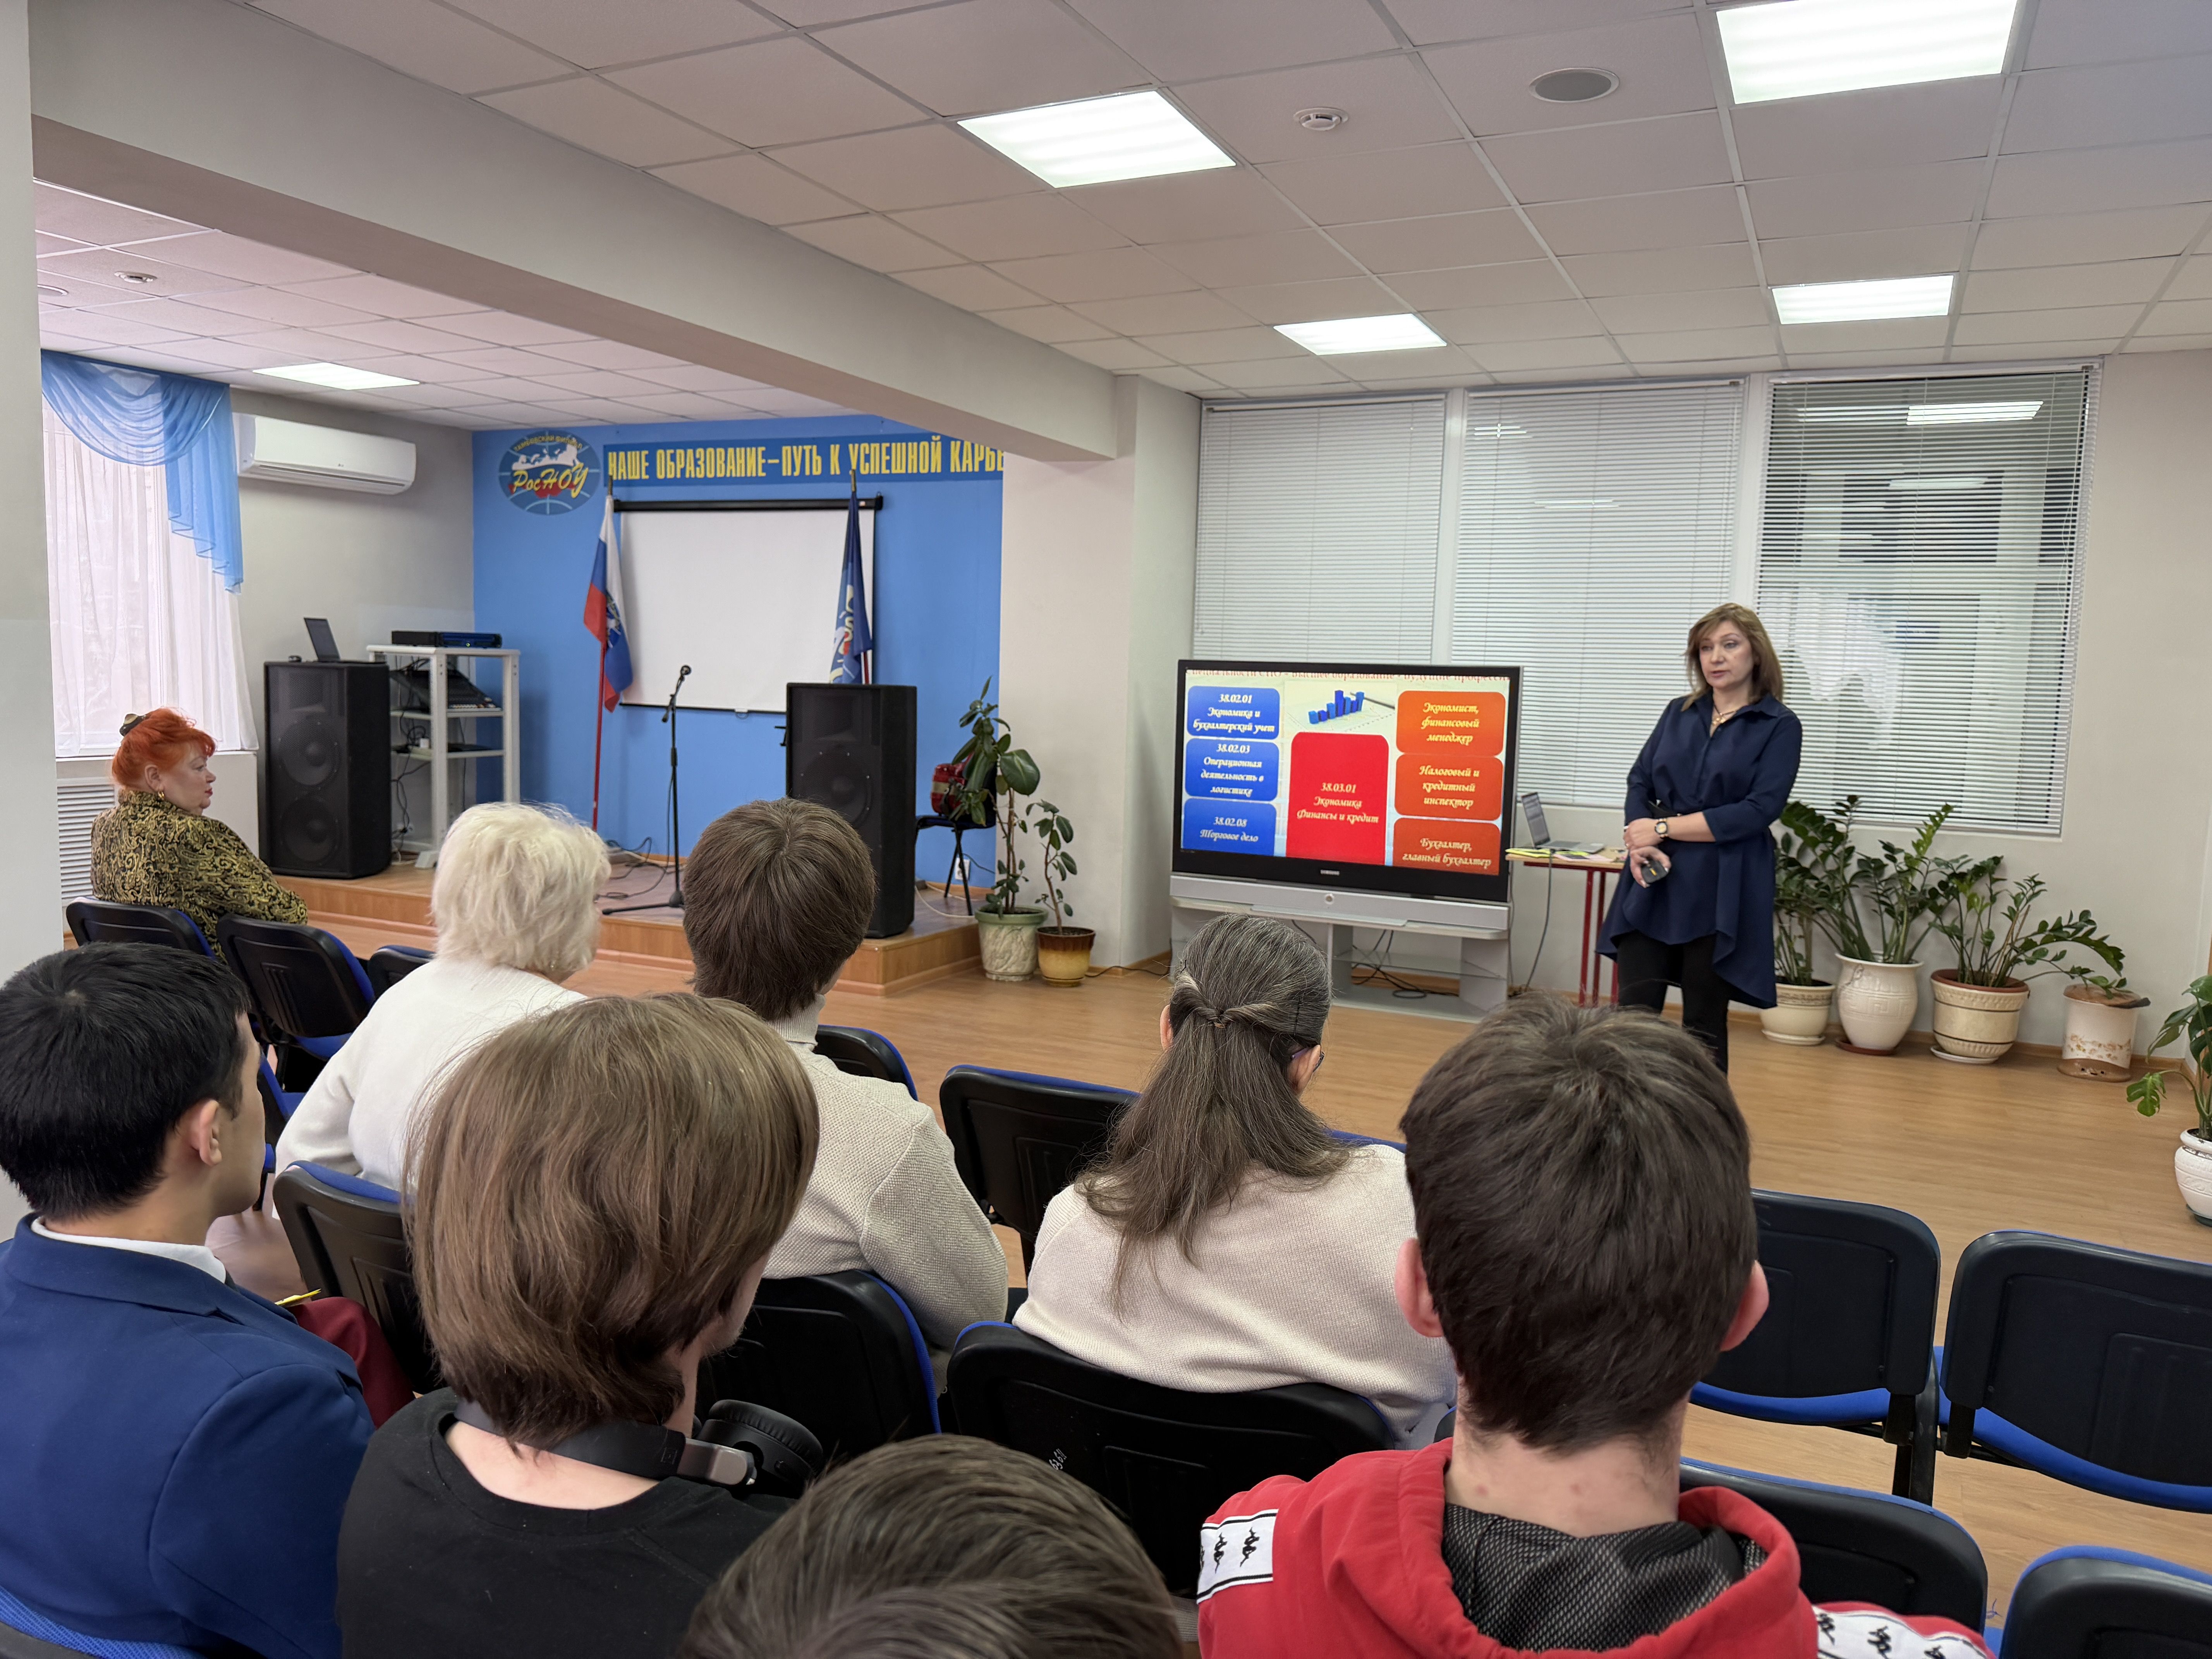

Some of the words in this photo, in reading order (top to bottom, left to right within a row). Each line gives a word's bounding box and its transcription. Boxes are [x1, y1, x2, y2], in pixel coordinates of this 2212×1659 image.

[608, 451, 649, 480] НАШЕ
[830, 444, 840, 475] К
[848, 435, 941, 475] УСПЕШНОЙ
[514, 462, 589, 499] РосНОУ
[1218, 694, 1252, 704] 38.02.01
[1207, 707, 1253, 720] Экономика
[1422, 702, 1479, 714] Экономист,
[1193, 718, 1253, 733] бухгалтерский
[1253, 725, 1275, 734] учет
[1420, 716, 1480, 730] финансовый
[1426, 731, 1474, 746] менеджер
[1216, 744, 1251, 754] 38.02.03
[1203, 756, 1262, 769] Операционная
[1200, 769, 1258, 781] деятельность
[1419, 765, 1472, 777] Налоговый
[1210, 787, 1254, 797] логистике
[1320, 782, 1357, 793] 38.03.01
[1422, 780, 1476, 793] кредитный
[1313, 796, 1363, 810] Экономика
[1424, 797, 1474, 810] инспектор
[1213, 816, 1248, 828] 38.02.08
[1297, 809, 1338, 820] Финансы
[1347, 812, 1379, 825] кредит
[1200, 829, 1239, 842] Торговое
[1240, 831, 1259, 842] дело
[1420, 837, 1472, 853] Бухгалтер,
[1402, 853, 1441, 863] главный
[1442, 853, 1492, 870] бухгалтер
